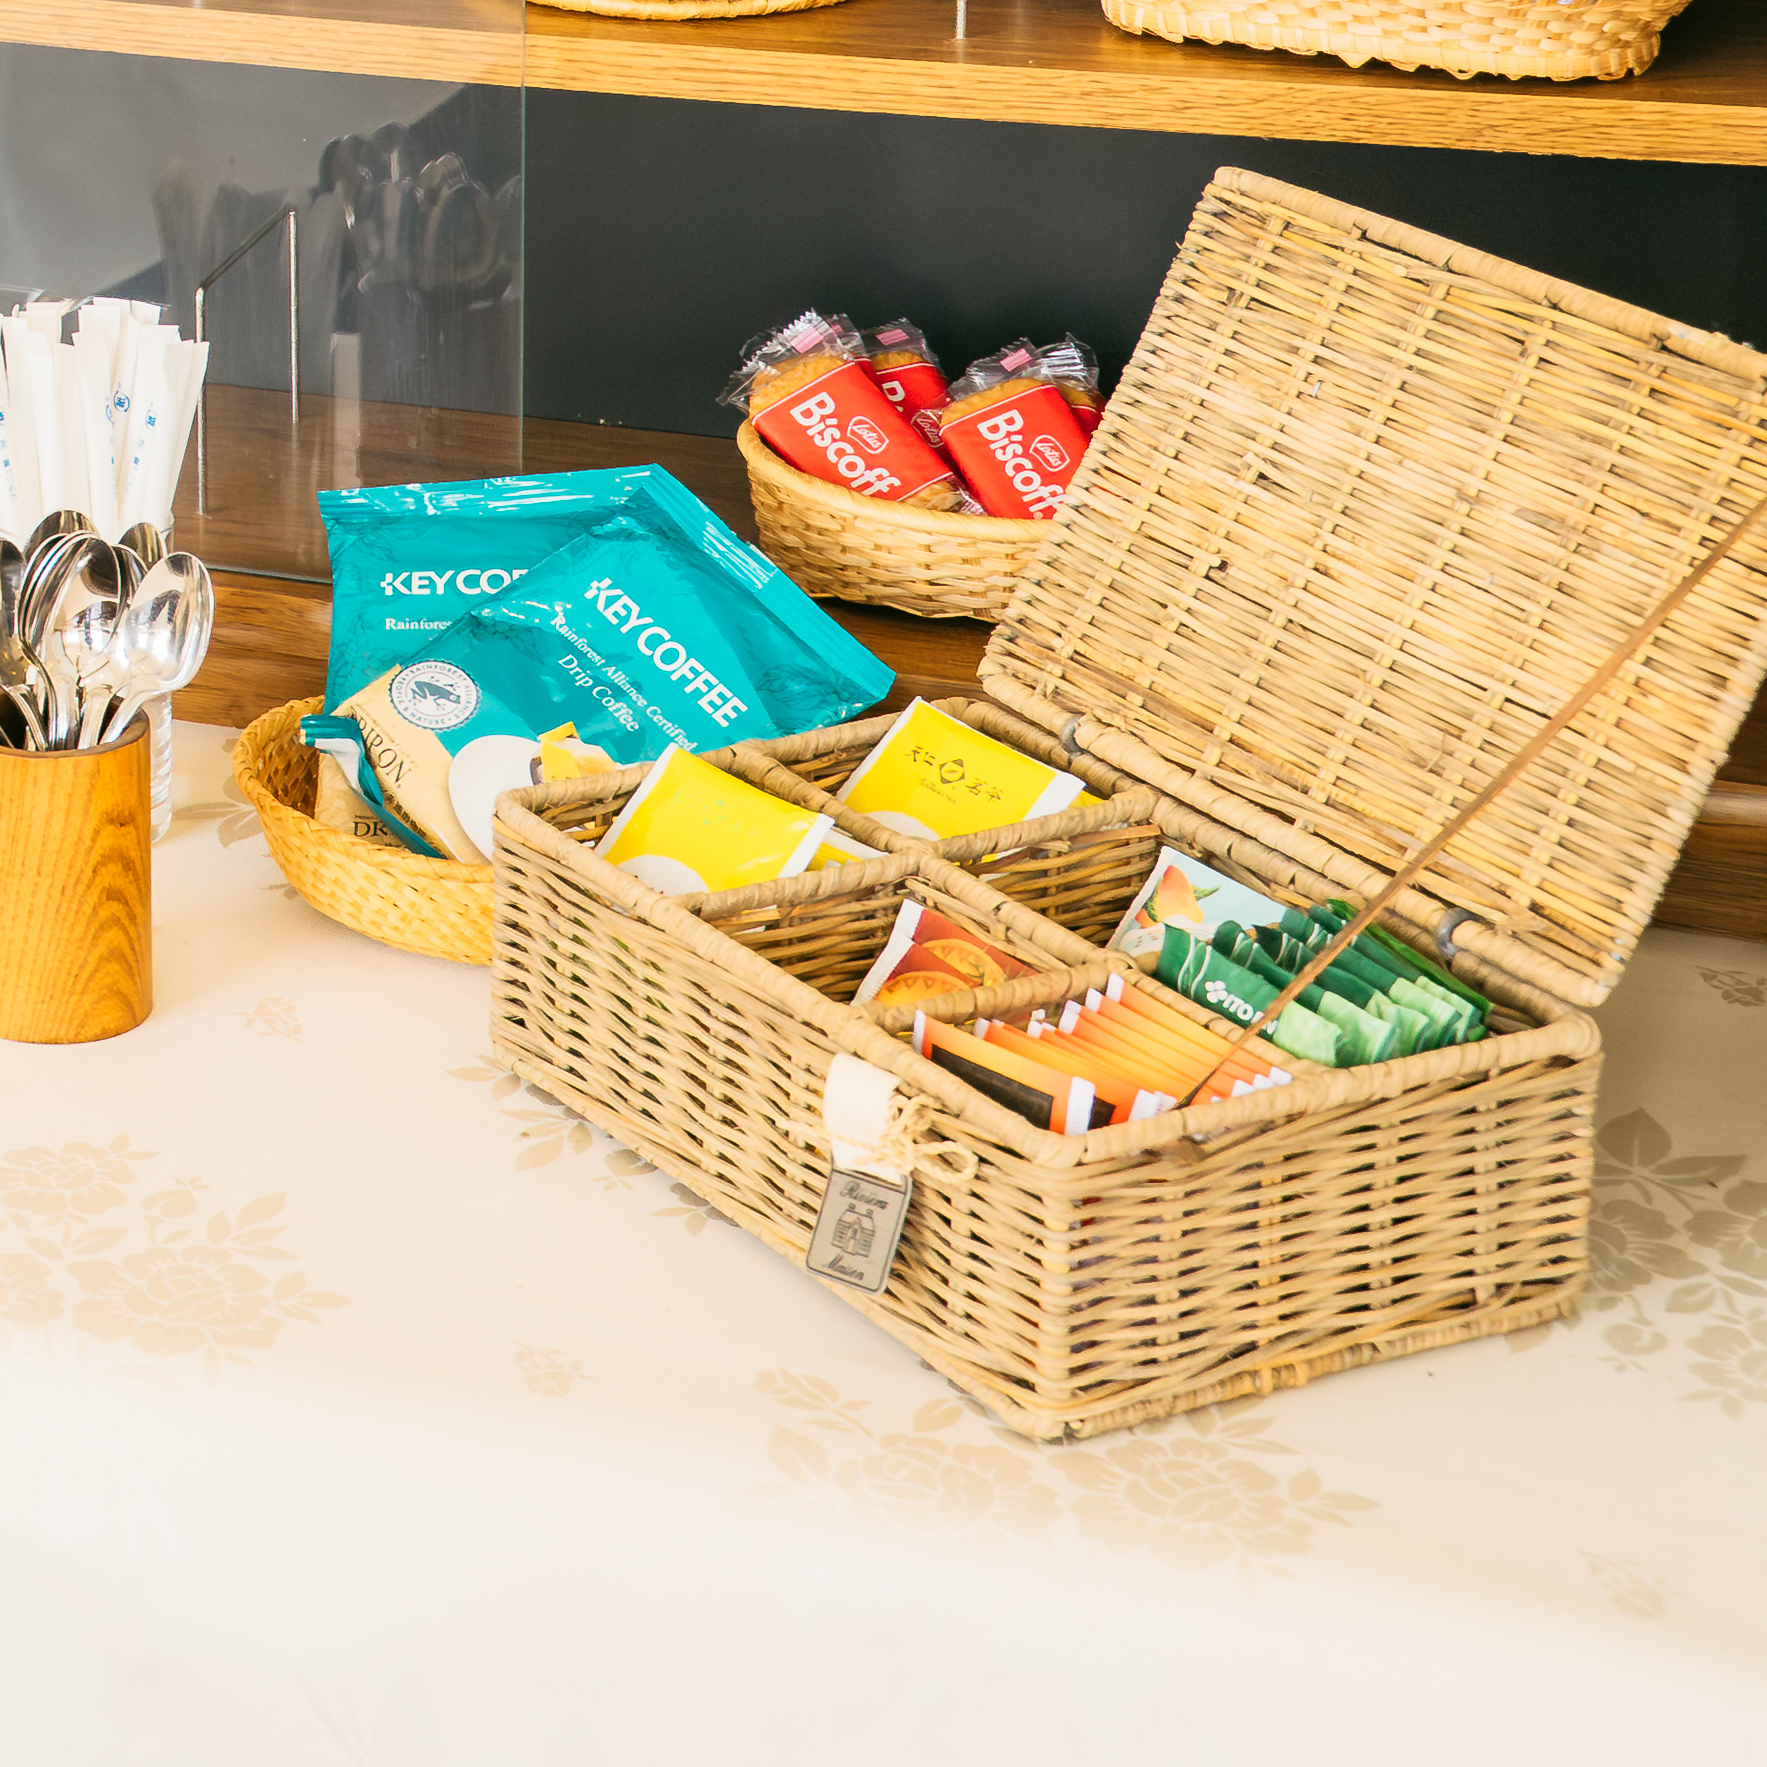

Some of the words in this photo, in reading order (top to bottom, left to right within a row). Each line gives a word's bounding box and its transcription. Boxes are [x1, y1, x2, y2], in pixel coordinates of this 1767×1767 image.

[789, 391, 902, 500] Biscoff
[853, 422, 882, 450] Lotus
[976, 409, 1068, 518] Biscoff
[1035, 442, 1065, 468] Lotus
[408, 662, 467, 682] RAINFOREST
[549, 612, 604, 667] Rainforest
[602, 663, 649, 707] Alliance
[644, 705, 699, 753] Certified
[453, 683, 473, 720] ALLIANCE
[557, 652, 594, 690] Drip
[591, 685, 640, 733] Coffee
[409, 711, 446, 726] NATURE
